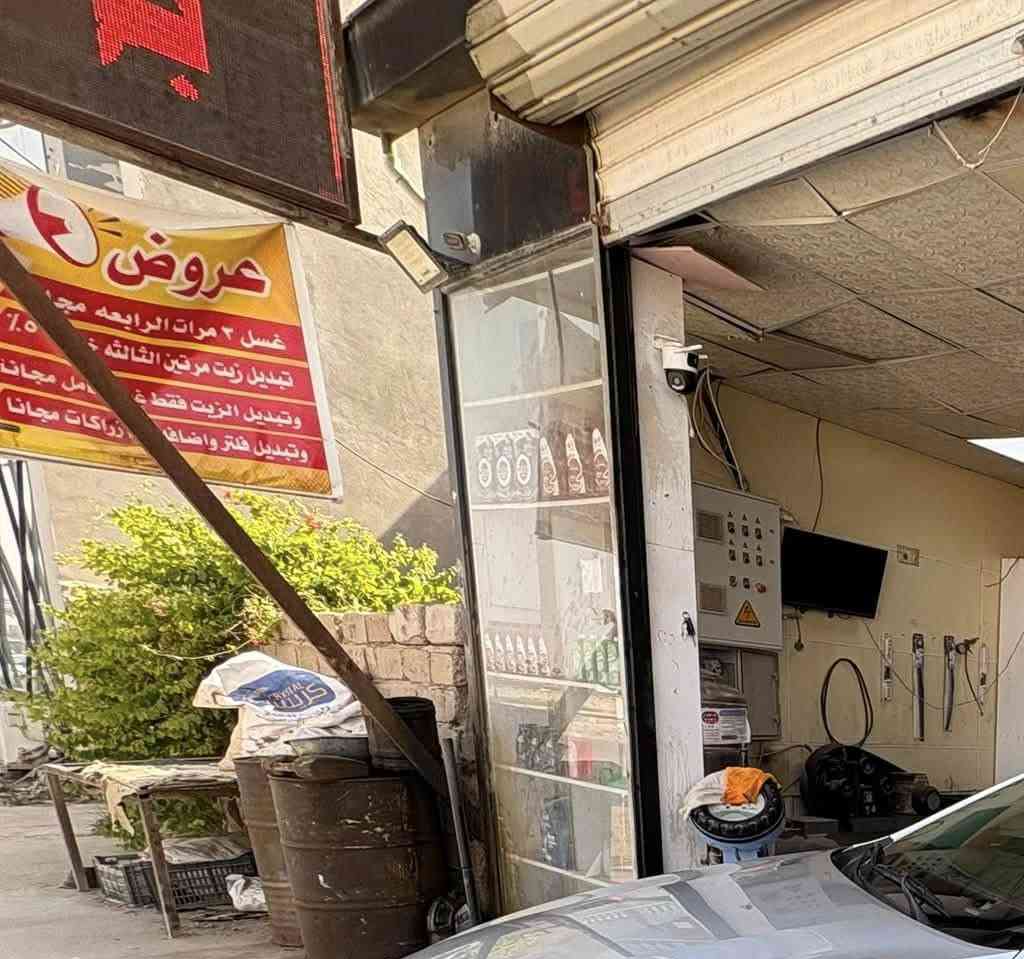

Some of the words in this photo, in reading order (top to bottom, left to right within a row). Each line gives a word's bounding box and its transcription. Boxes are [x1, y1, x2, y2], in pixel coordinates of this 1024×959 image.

[105, 230, 268, 301] عروض
[171, 318, 218, 341] مرات
[239, 328, 287, 350] غسل
[162, 353, 211, 378] مرتين
[212, 361, 244, 385] زيت
[246, 366, 294, 390] تبديل
[6, 396, 60, 423] مجانا
[150, 391, 188, 411] فقط
[190, 398, 240, 419] الزيت
[243, 406, 303, 430] وتبديل
[219, 434, 251, 452] فلتر
[253, 438, 309, 464] وتبديل
